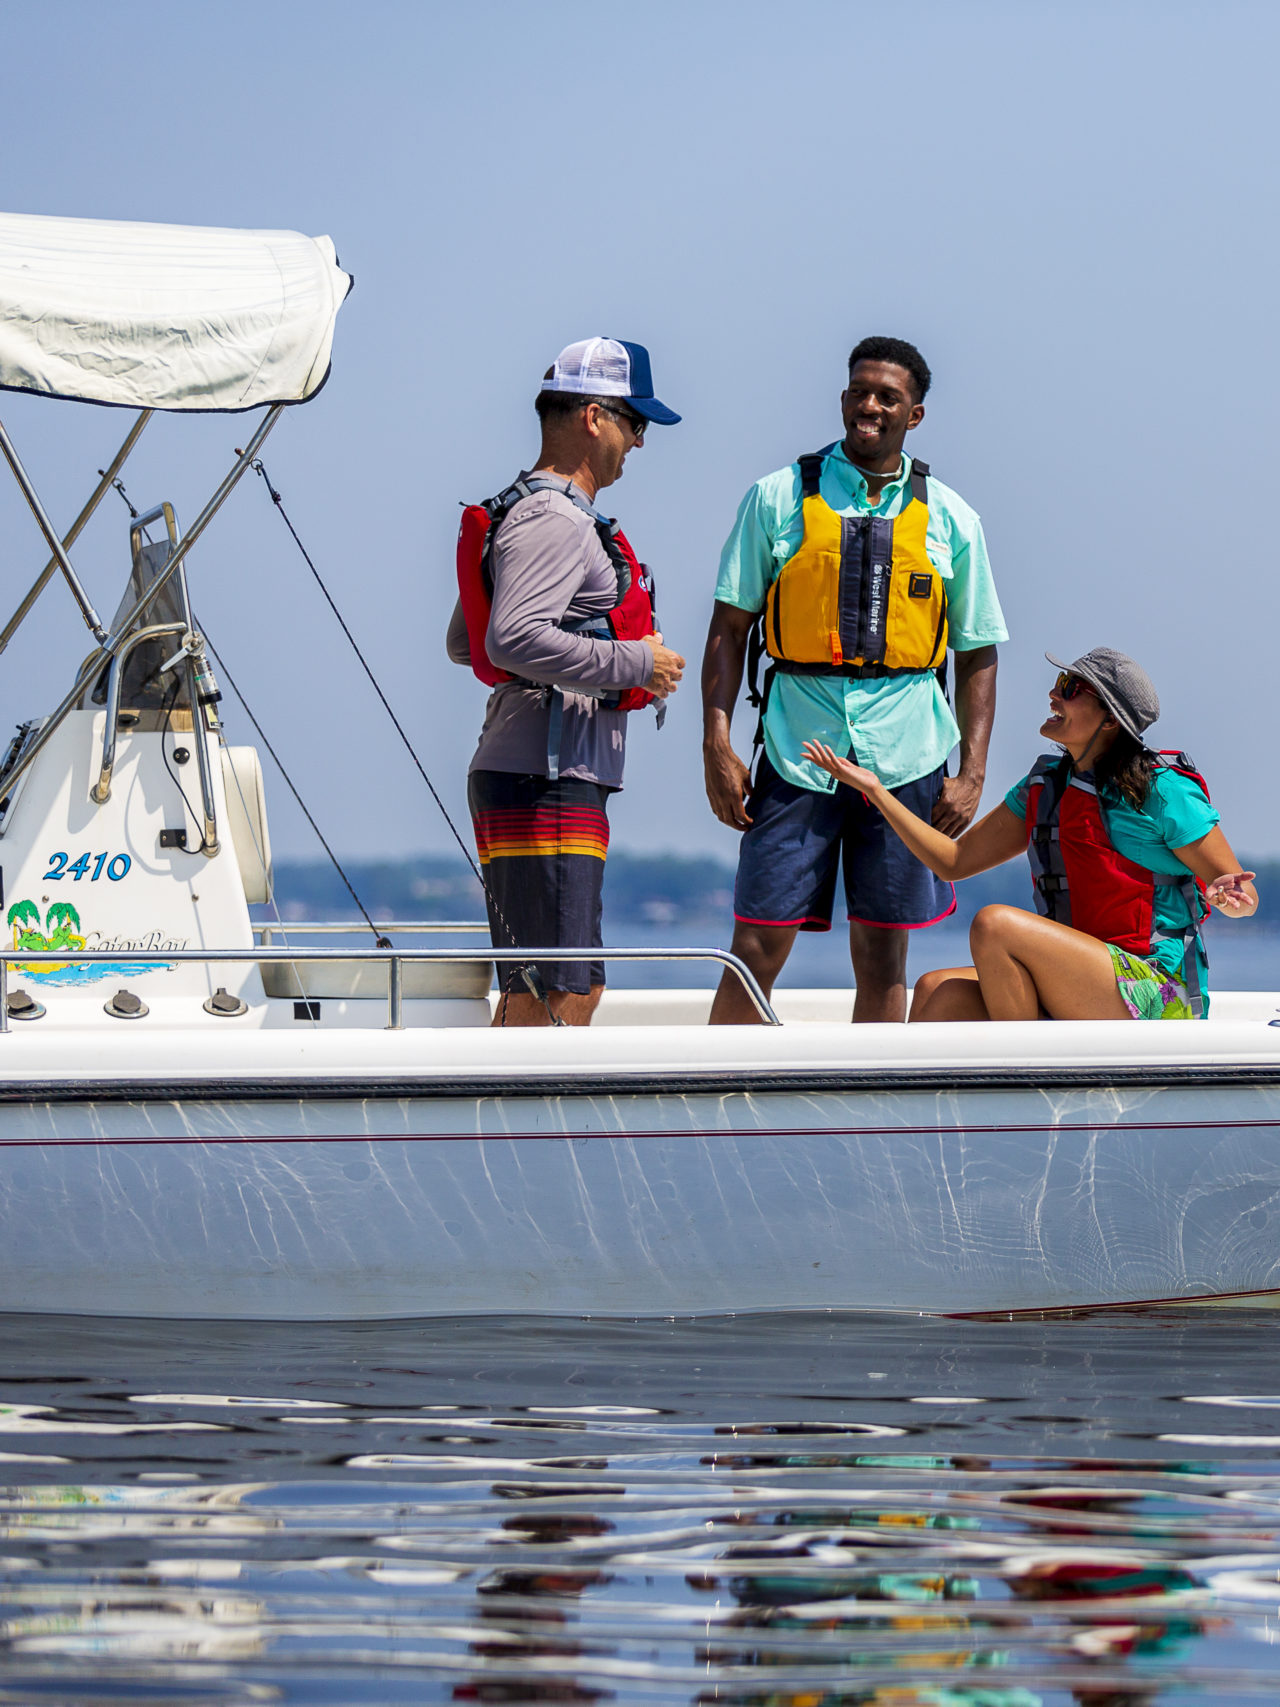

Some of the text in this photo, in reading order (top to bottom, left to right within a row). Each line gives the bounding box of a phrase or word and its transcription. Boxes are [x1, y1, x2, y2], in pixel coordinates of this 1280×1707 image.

[870, 576, 882, 632] West Marine
[42, 851, 132, 882] 2410
